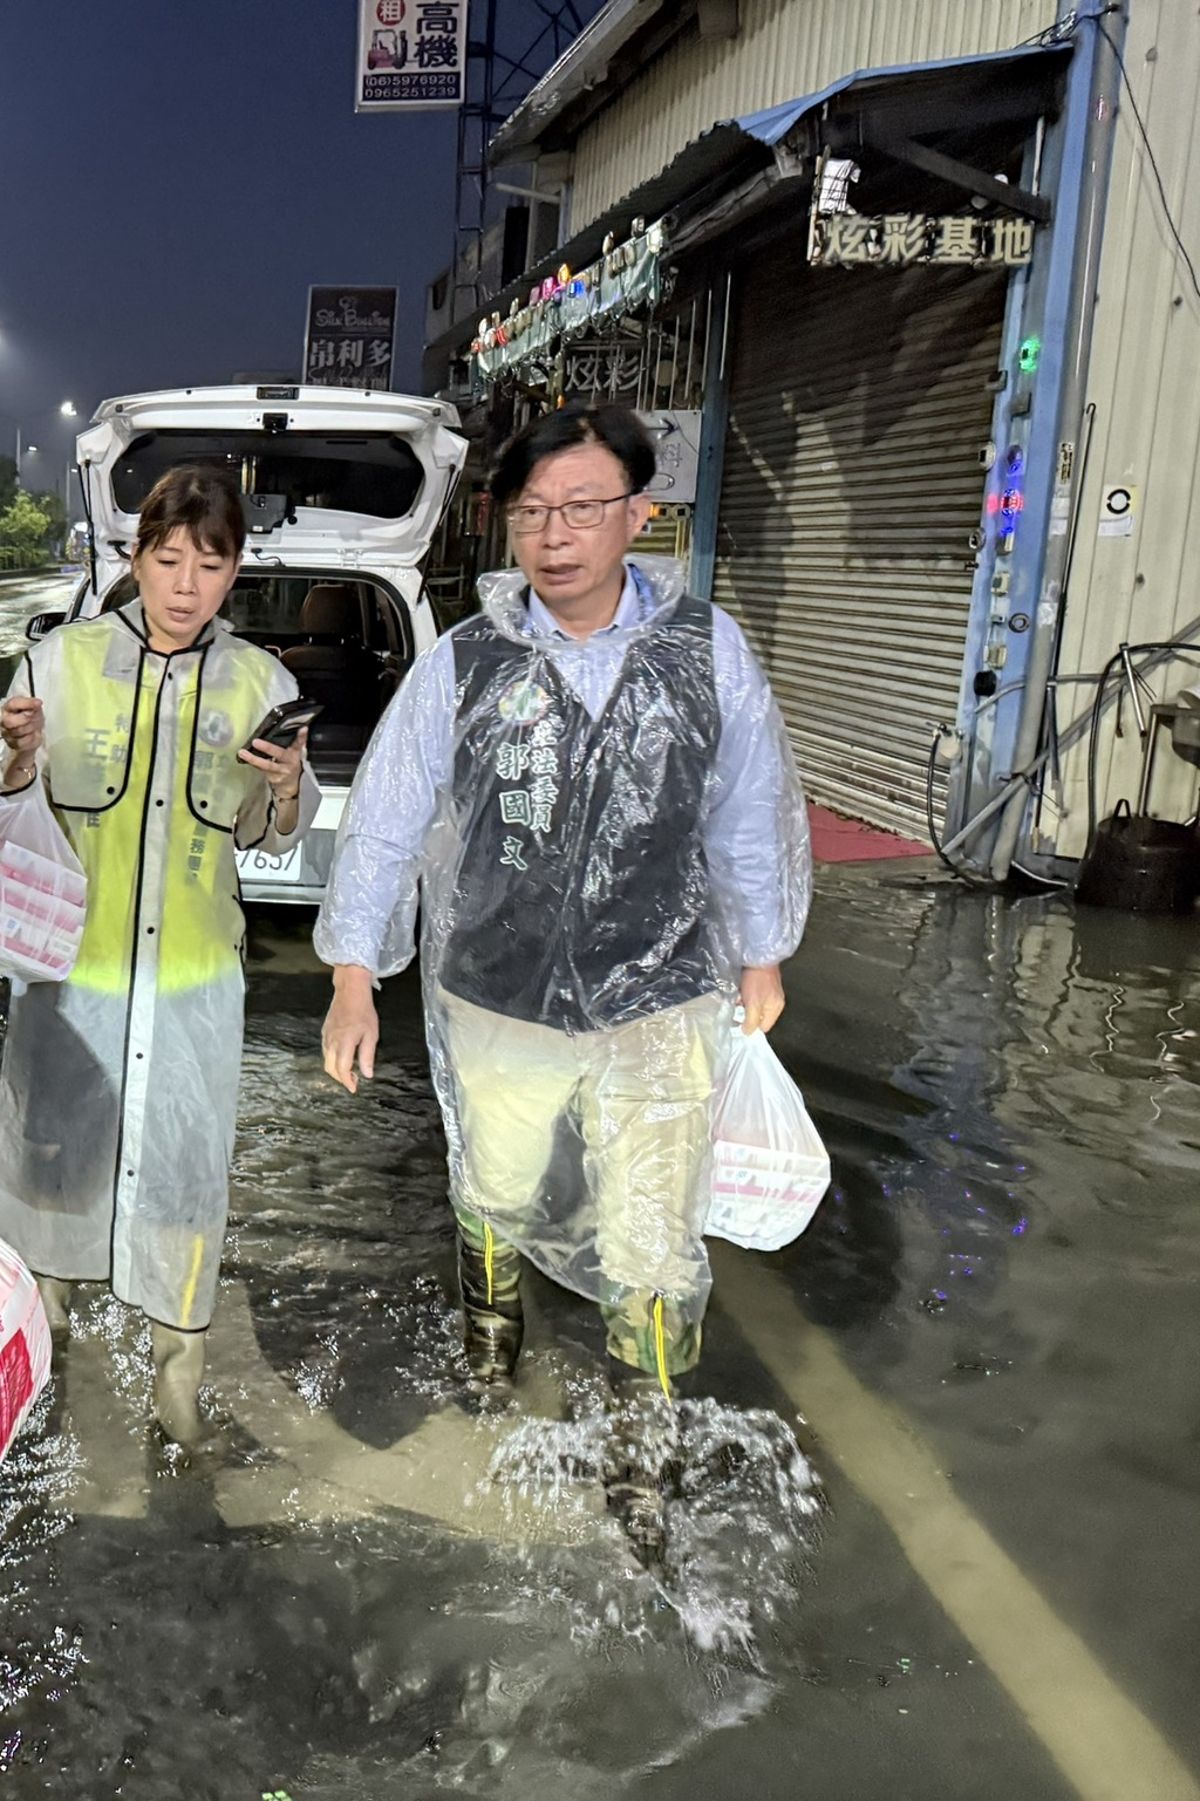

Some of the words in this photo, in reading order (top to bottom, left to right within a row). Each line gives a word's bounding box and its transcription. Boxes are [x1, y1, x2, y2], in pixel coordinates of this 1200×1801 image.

[414, 1, 458, 68] 高機
[826, 213, 1033, 264] 炫彩基地
[565, 353, 640, 392] 炫彩
[496, 742, 531, 871] 郭國文
